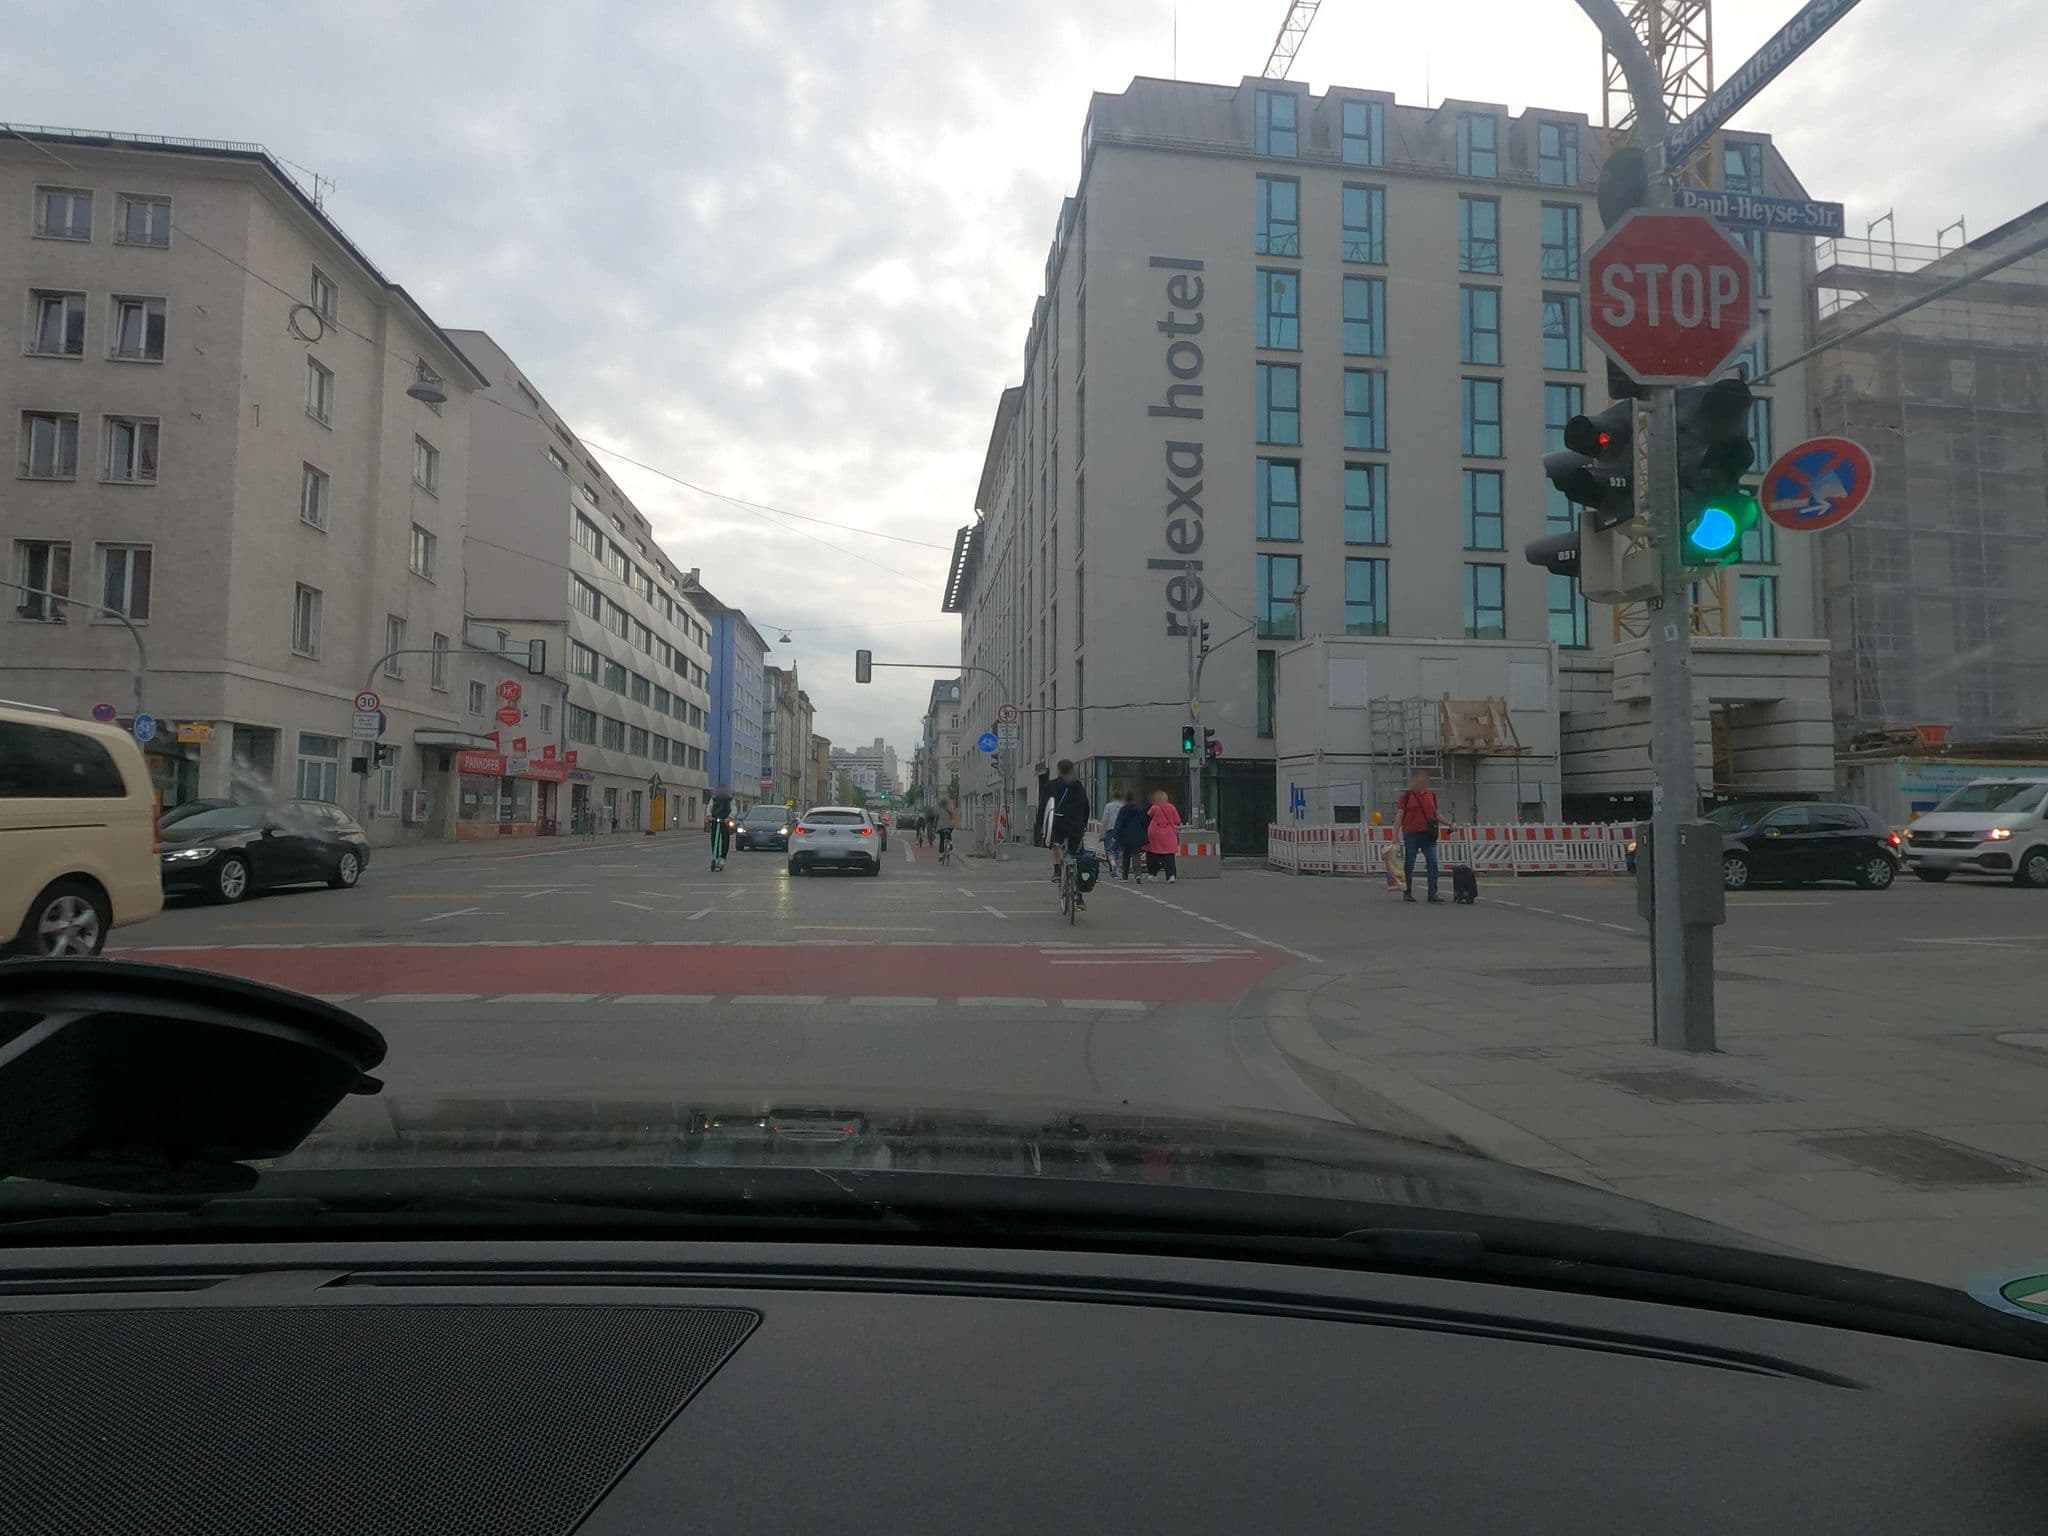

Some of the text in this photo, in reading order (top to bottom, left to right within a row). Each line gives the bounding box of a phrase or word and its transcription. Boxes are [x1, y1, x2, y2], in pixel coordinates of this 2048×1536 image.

[1682, 191, 1839, 228] Paul-Heyse-Str.
[1601, 263, 1739, 330] STOP
[1148, 255, 1204, 637] relexa hotel
[359, 697, 375, 708] 30
[464, 755, 500, 772] PANKOFER
